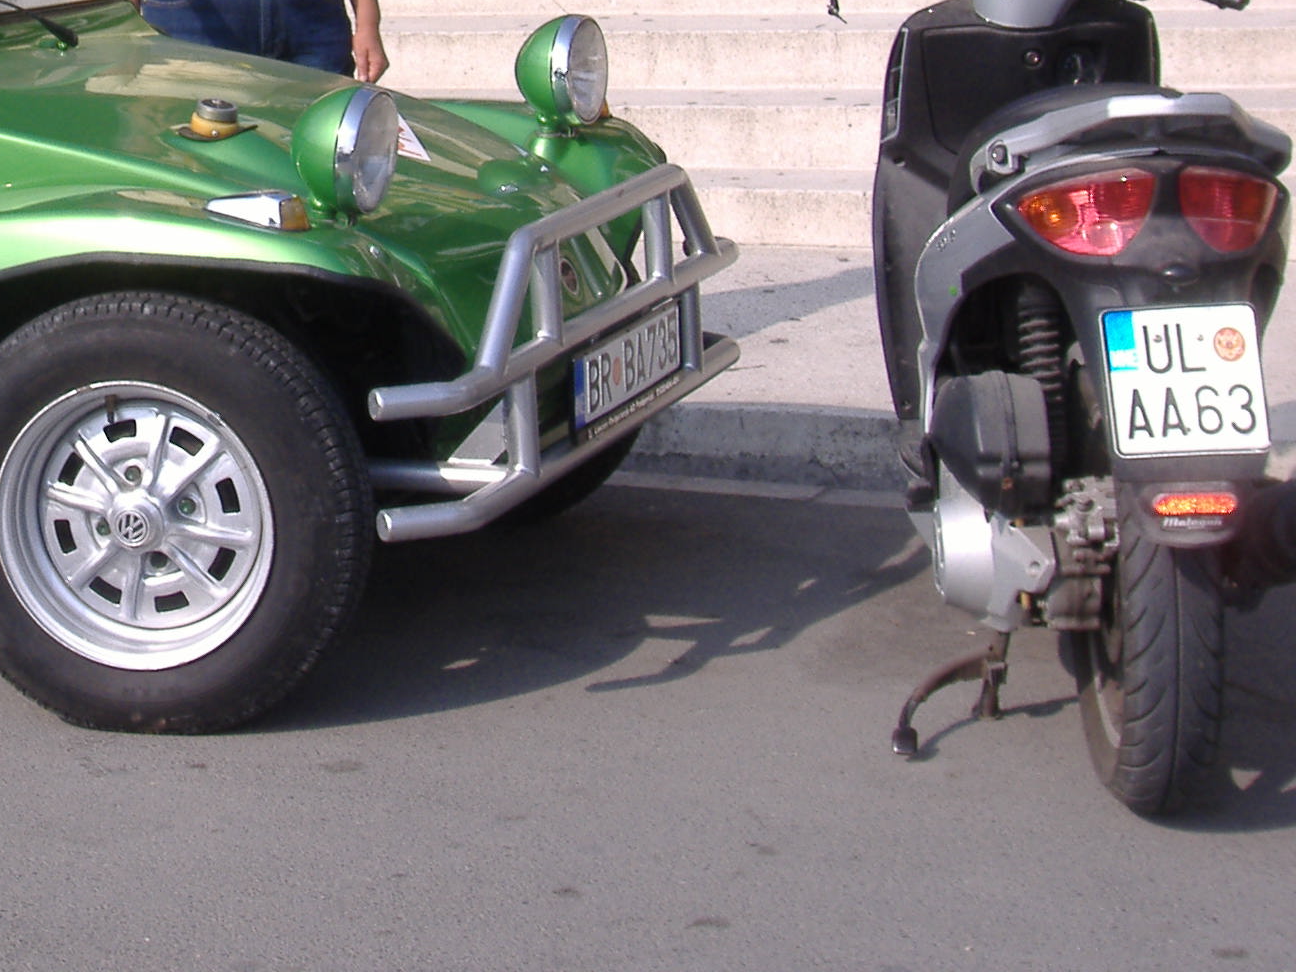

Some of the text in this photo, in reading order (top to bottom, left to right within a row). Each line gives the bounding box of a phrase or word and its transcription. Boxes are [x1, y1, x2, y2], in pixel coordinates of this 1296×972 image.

[586, 315, 678, 415] BR BA735
[1142, 323, 1207, 374] UL
[1128, 383, 1257, 440] AA63
